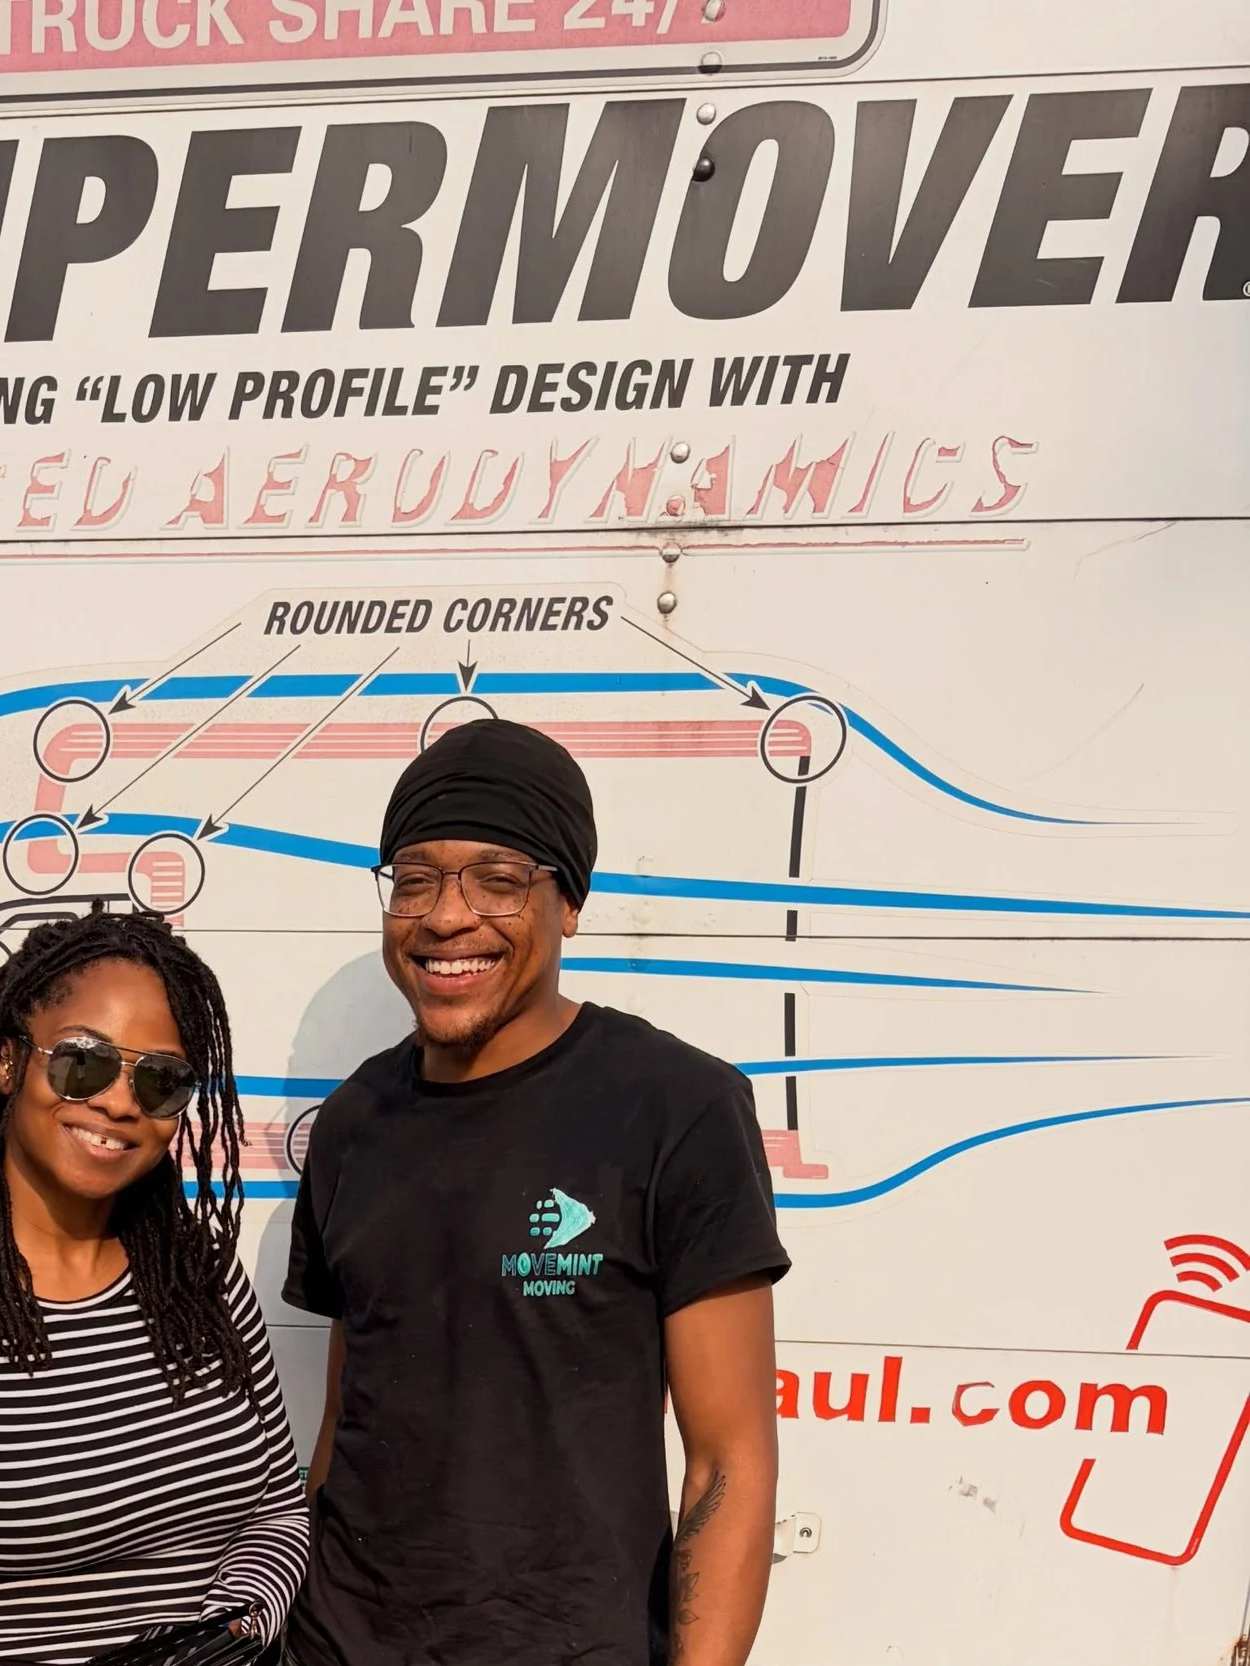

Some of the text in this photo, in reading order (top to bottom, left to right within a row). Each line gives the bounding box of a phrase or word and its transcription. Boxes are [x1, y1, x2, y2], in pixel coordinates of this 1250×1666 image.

[269, 0, 536, 43] SHARE
[489, 358, 694, 414] DESIGN
[708, 352, 850, 408] WITH
[160, 430, 1039, 534] AERODYNAMICS
[263, 595, 614, 636] ROUNDED CORNERS
[502, 1252, 603, 1277] MOVEMINT
[523, 1280, 575, 1297] MOVING
[775, 1356, 1168, 1435] aul.com
